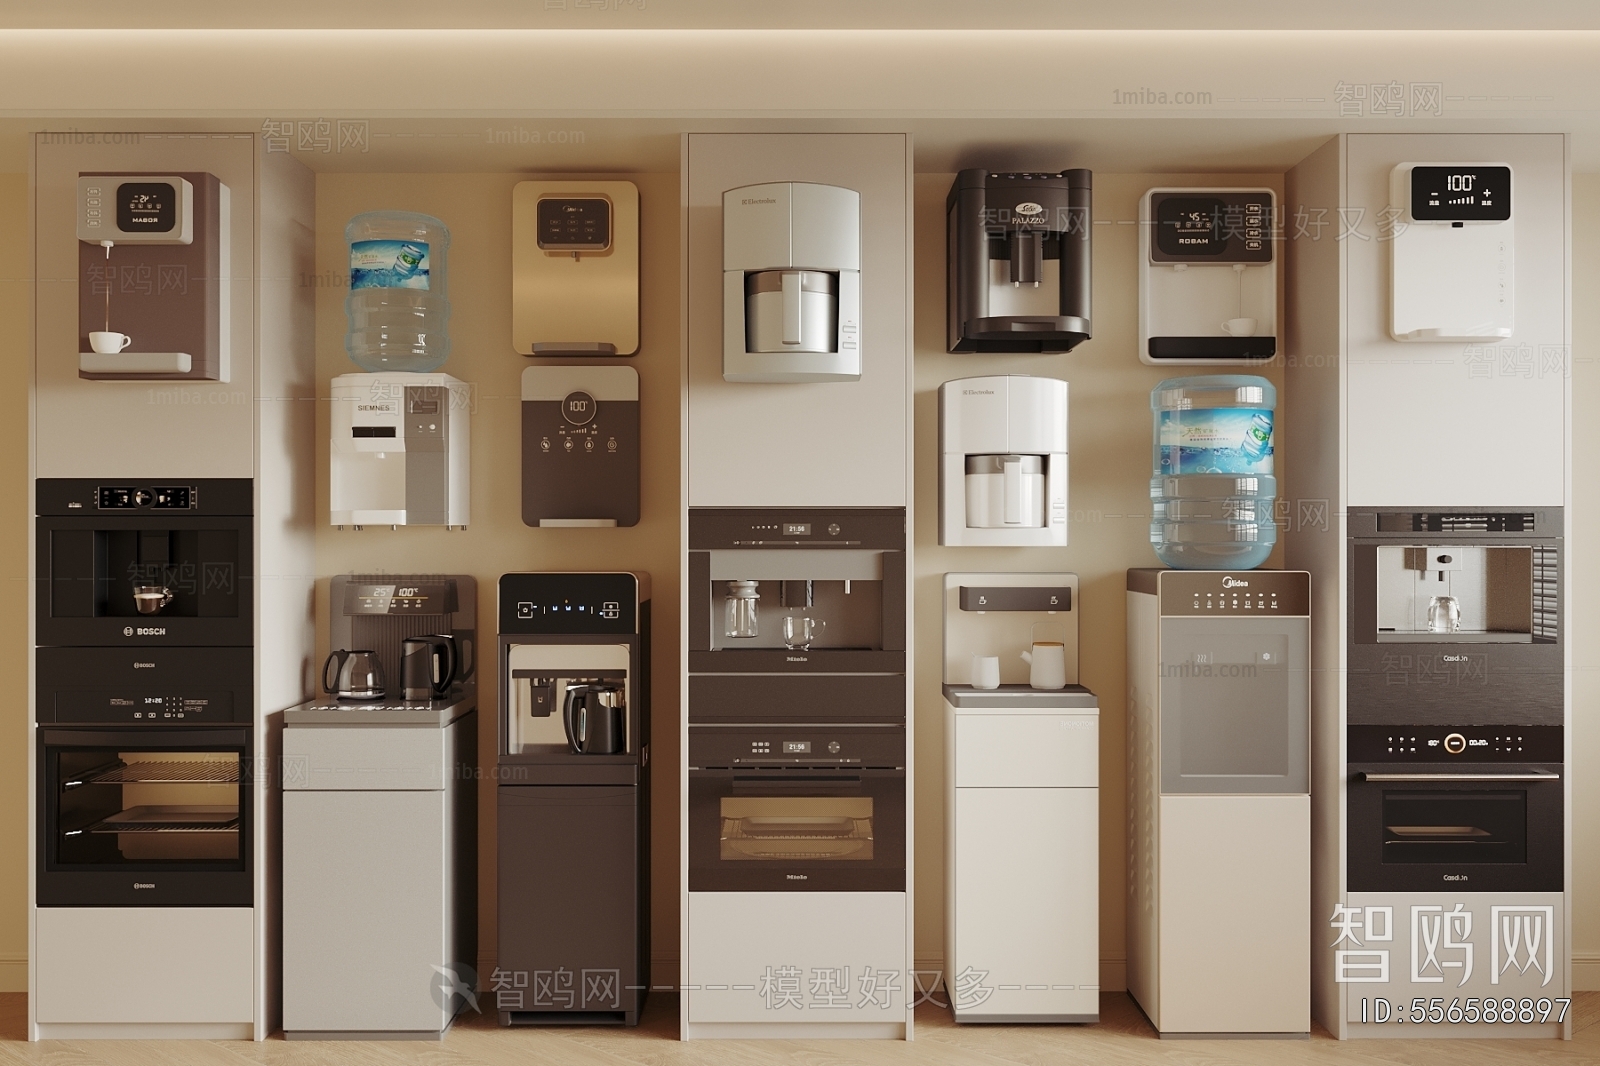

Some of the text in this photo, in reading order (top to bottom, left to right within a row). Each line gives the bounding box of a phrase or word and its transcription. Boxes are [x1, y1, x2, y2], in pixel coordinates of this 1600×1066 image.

[748, 197, 776, 205] Electrolux
[1189, 212, 1200, 221] 45
[357, 404, 390, 412] SIEMNES
[136, 627, 166, 636] BOSCH
